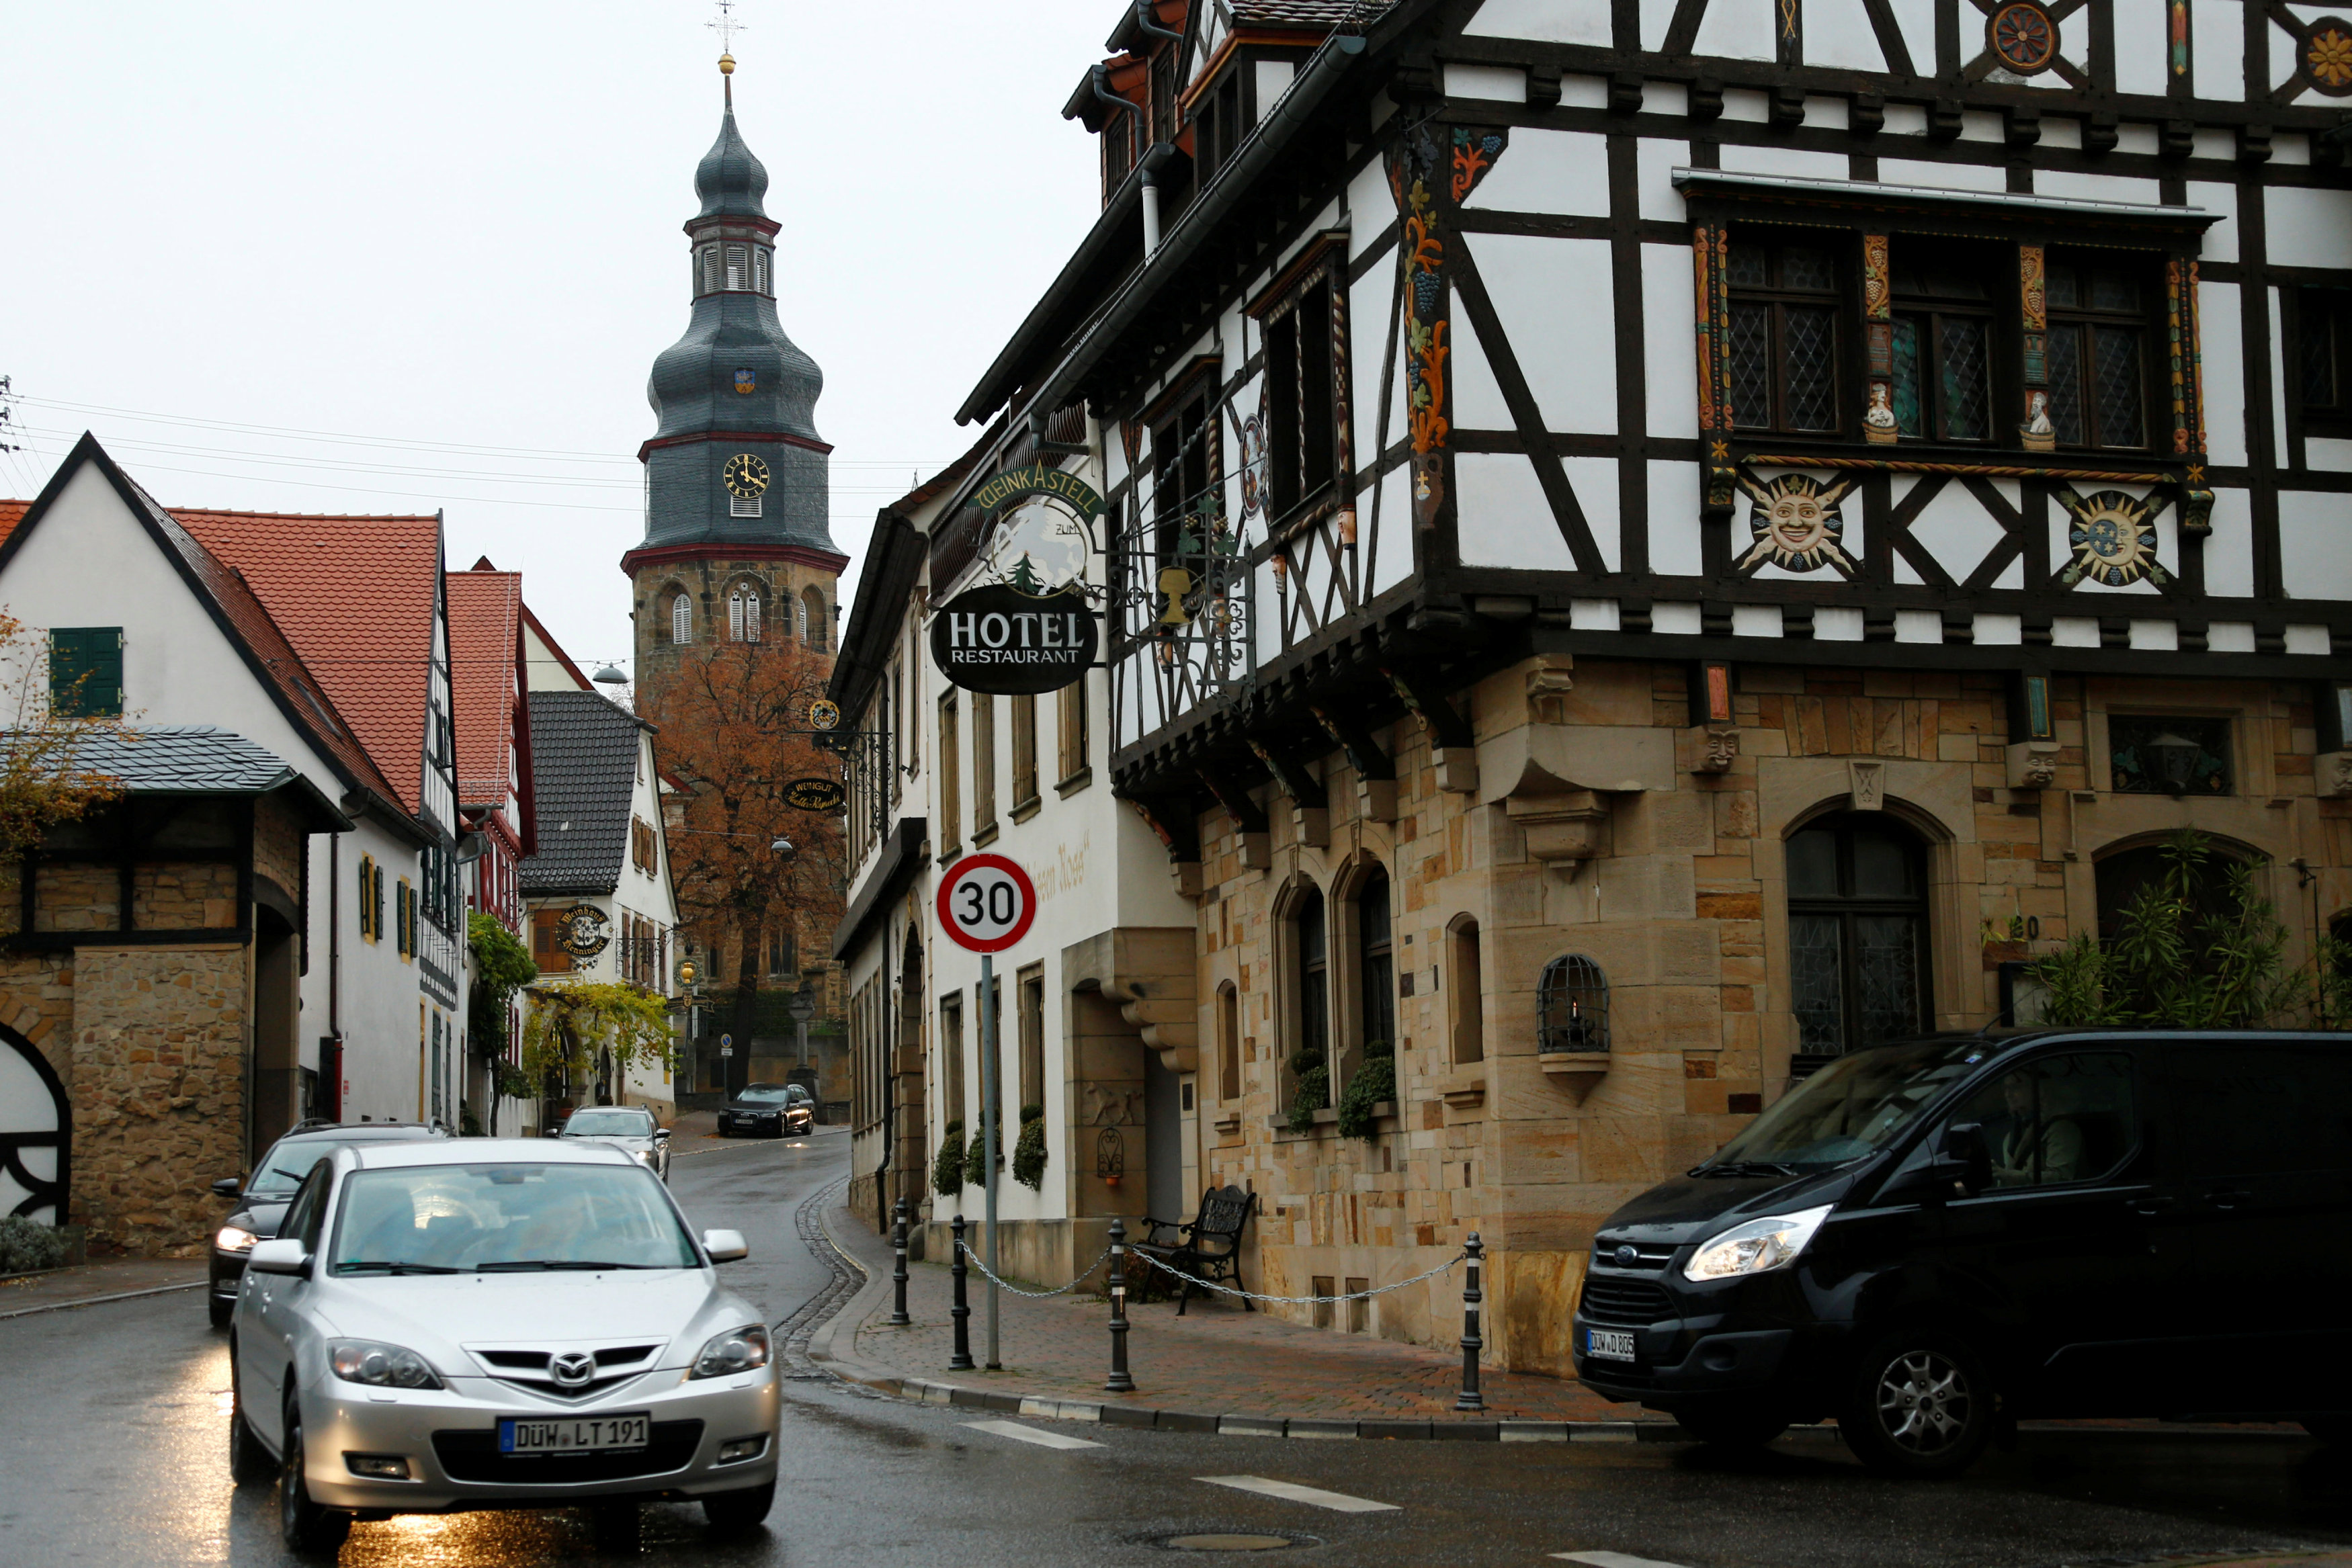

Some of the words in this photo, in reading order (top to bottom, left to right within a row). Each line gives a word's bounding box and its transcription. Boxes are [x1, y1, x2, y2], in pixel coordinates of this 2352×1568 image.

[1056, 523, 1077, 535] ZUM
[950, 612, 1084, 648] HOTEL
[952, 650, 1079, 663] RESTAURANT
[796, 782, 833, 792] WEINGUT
[958, 881, 1014, 926] 30
[561, 906, 606, 924] Weinhaus
[562, 939, 605, 955] Henninger
